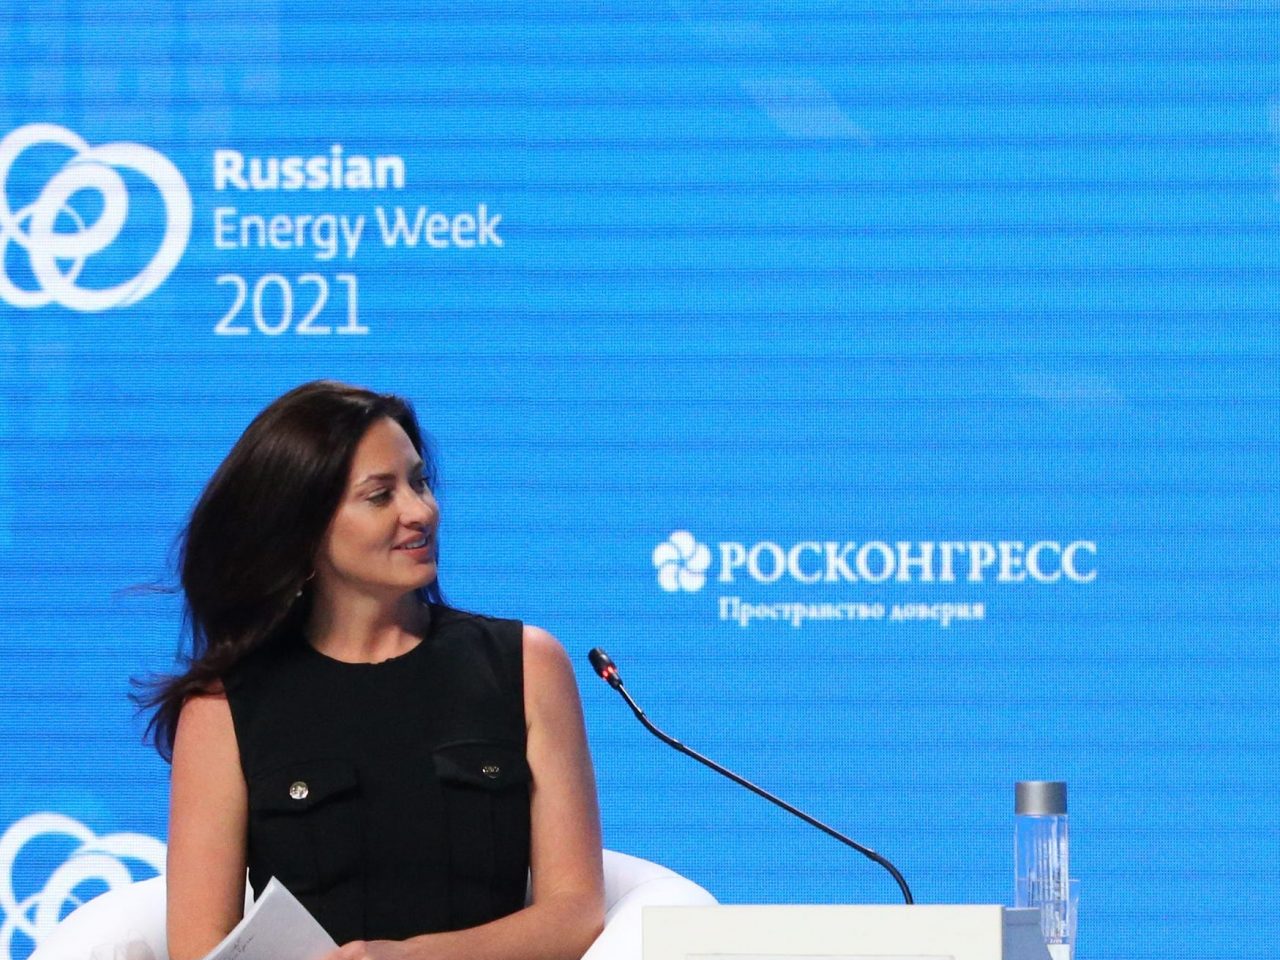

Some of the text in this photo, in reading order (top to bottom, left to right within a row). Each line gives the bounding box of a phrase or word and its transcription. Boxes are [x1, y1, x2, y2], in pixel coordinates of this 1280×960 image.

[213, 145, 405, 190] Russian
[214, 204, 503, 259] Energy Week
[214, 273, 369, 336] 2021
[719, 541, 1096, 583] РОСКОНГРЕСС
[719, 597, 985, 627] Пространство доверия
